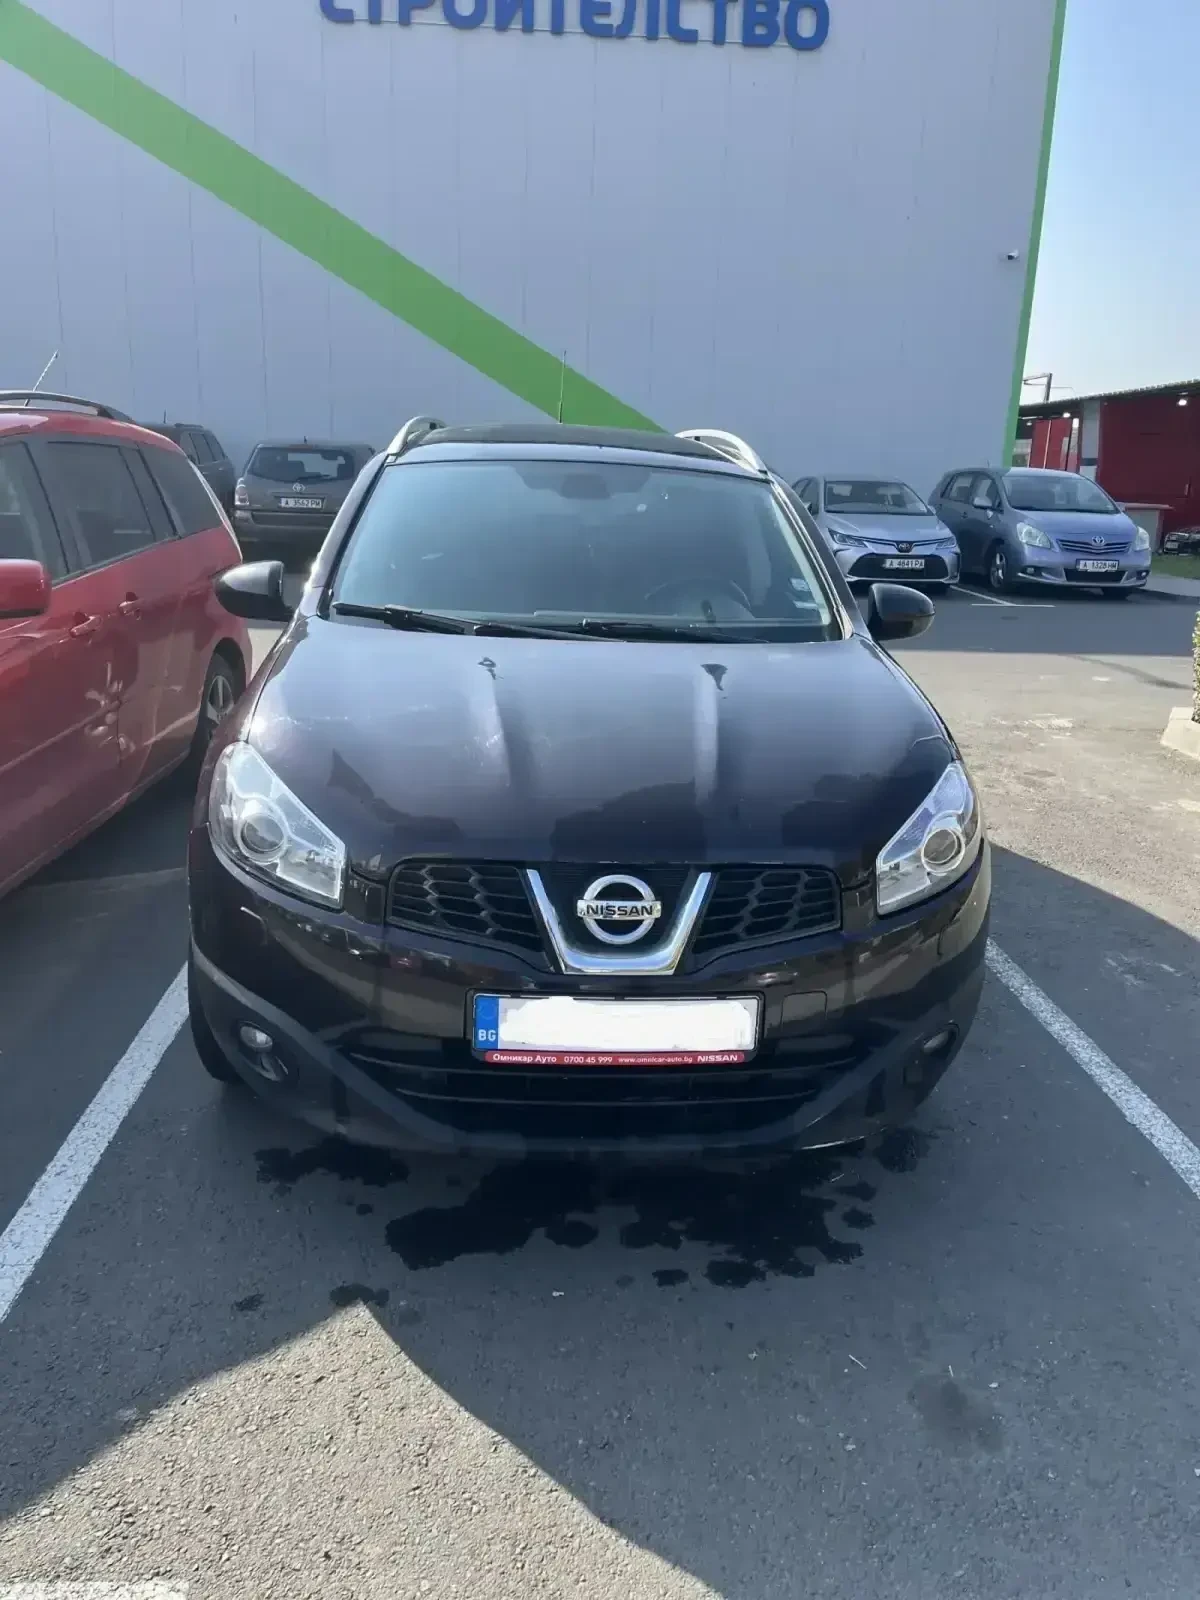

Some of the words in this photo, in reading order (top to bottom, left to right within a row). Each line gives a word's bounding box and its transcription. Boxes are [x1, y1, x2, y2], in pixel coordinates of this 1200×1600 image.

[586, 904, 653, 916] NISSAN
[478, 1029, 497, 1042] BG
[492, 1053, 533, 1063] Омникар
[536, 1055, 557, 1064] Ауто
[564, 1056, 585, 1064] 0700
[585, 1056, 596, 1064] 45
[598, 1056, 613, 1064] 999
[618, 1055, 693, 1064] www.omnicar-auto.bg
[697, 1054, 738, 1063] NISSAN
